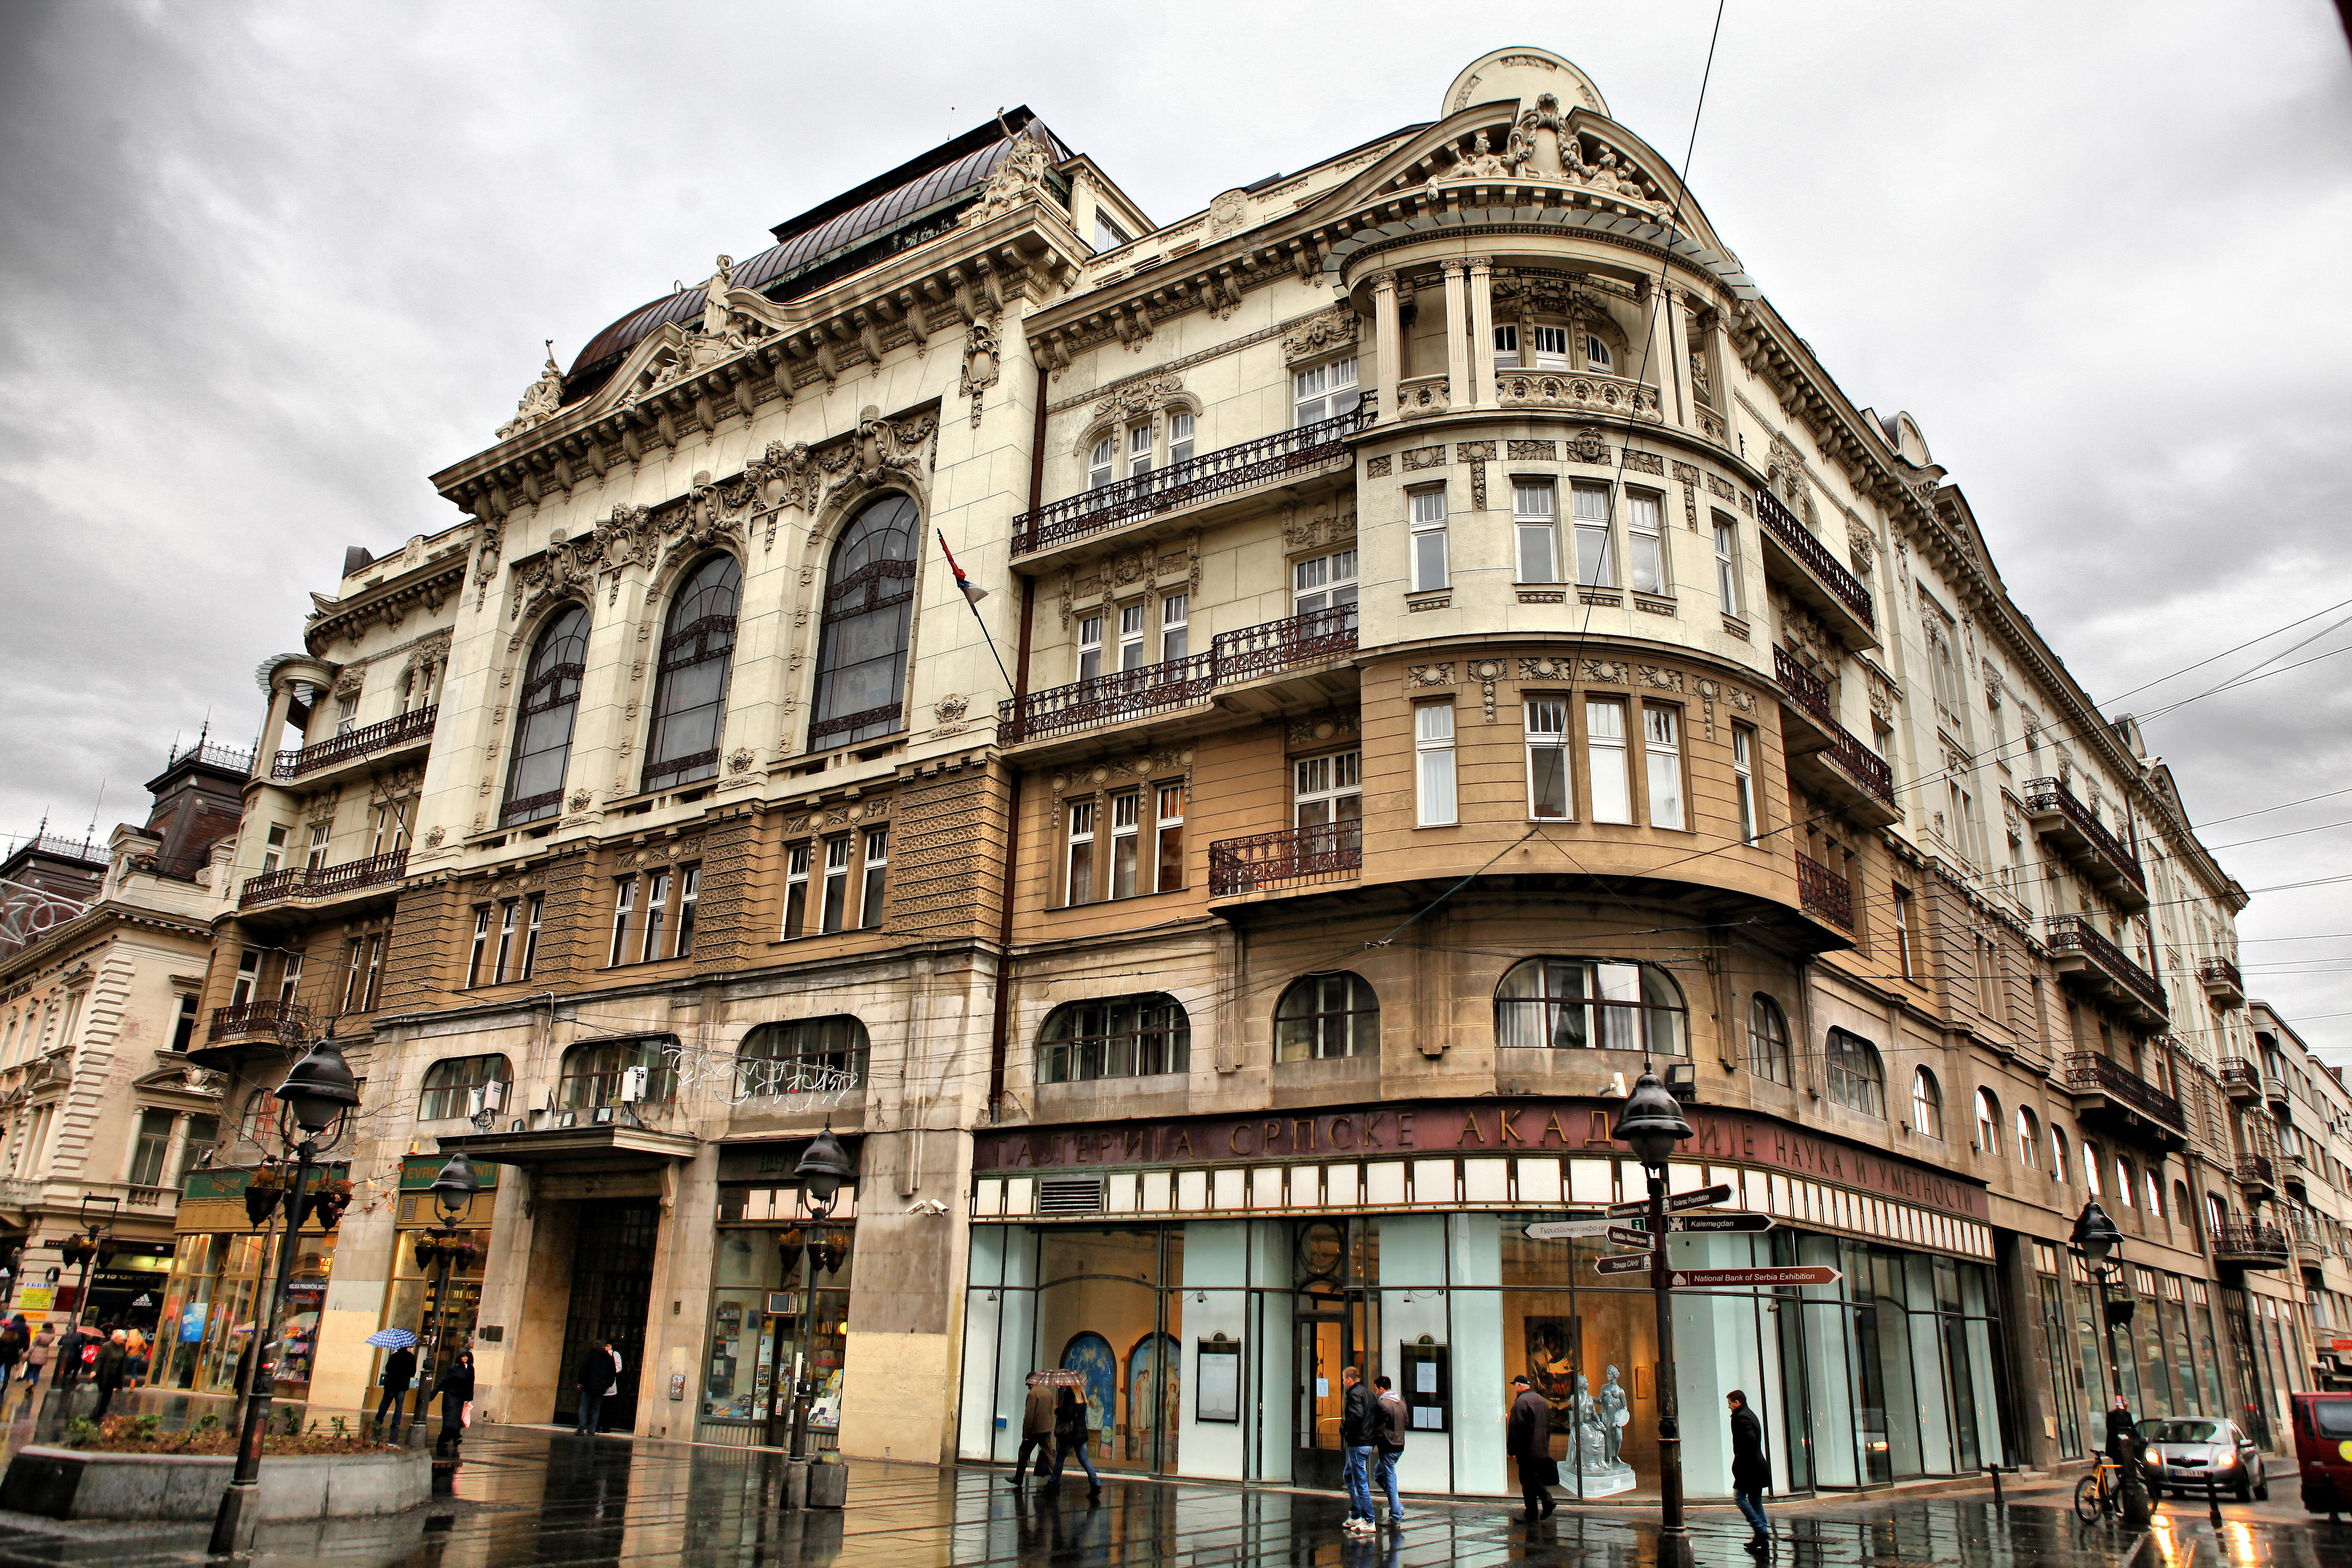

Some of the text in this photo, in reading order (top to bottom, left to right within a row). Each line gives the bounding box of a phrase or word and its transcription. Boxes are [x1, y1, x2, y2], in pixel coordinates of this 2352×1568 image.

[994, 1110, 1973, 1212] ГАЛЕРИЈА СРПСКЕ АКАДИЈЕ НАУКА И УМЕТНОСТИ
[407, 1166, 439, 1179] EVRO
[1688, 1194, 1709, 1204] Foundation
[1540, 1226, 1578, 1234] Туристички
